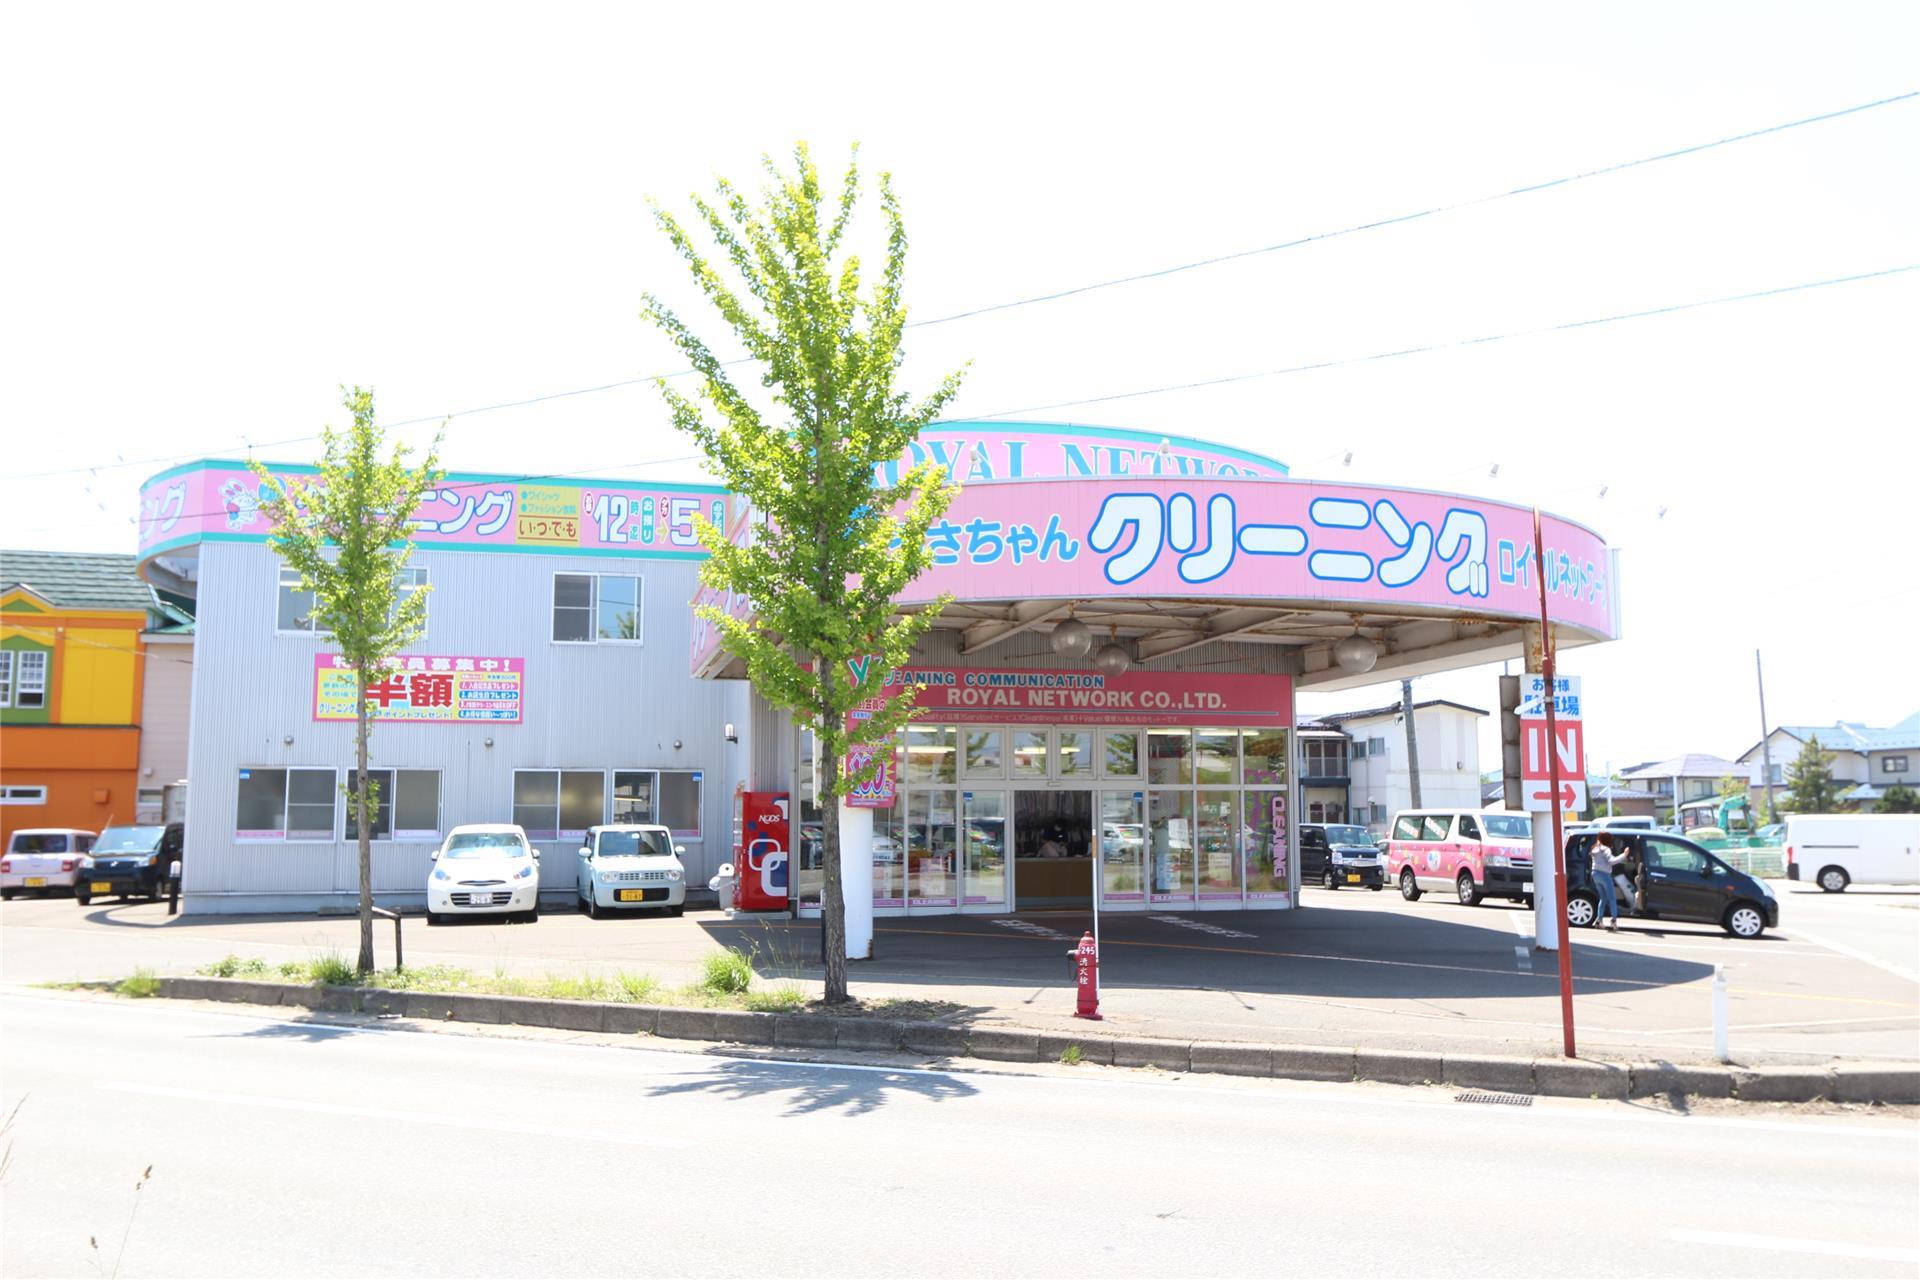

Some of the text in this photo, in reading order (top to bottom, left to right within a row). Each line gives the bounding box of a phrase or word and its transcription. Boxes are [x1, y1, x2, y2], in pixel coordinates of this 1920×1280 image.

[593, 494, 628, 543] 12
[1087, 492, 1490, 599] クリーニング
[947, 688, 1227, 710] ROYAL NETWORK CO.,LTD.
[965, 672, 1105, 688] COMMUNICATION
[1528, 727, 1578, 773] IN
